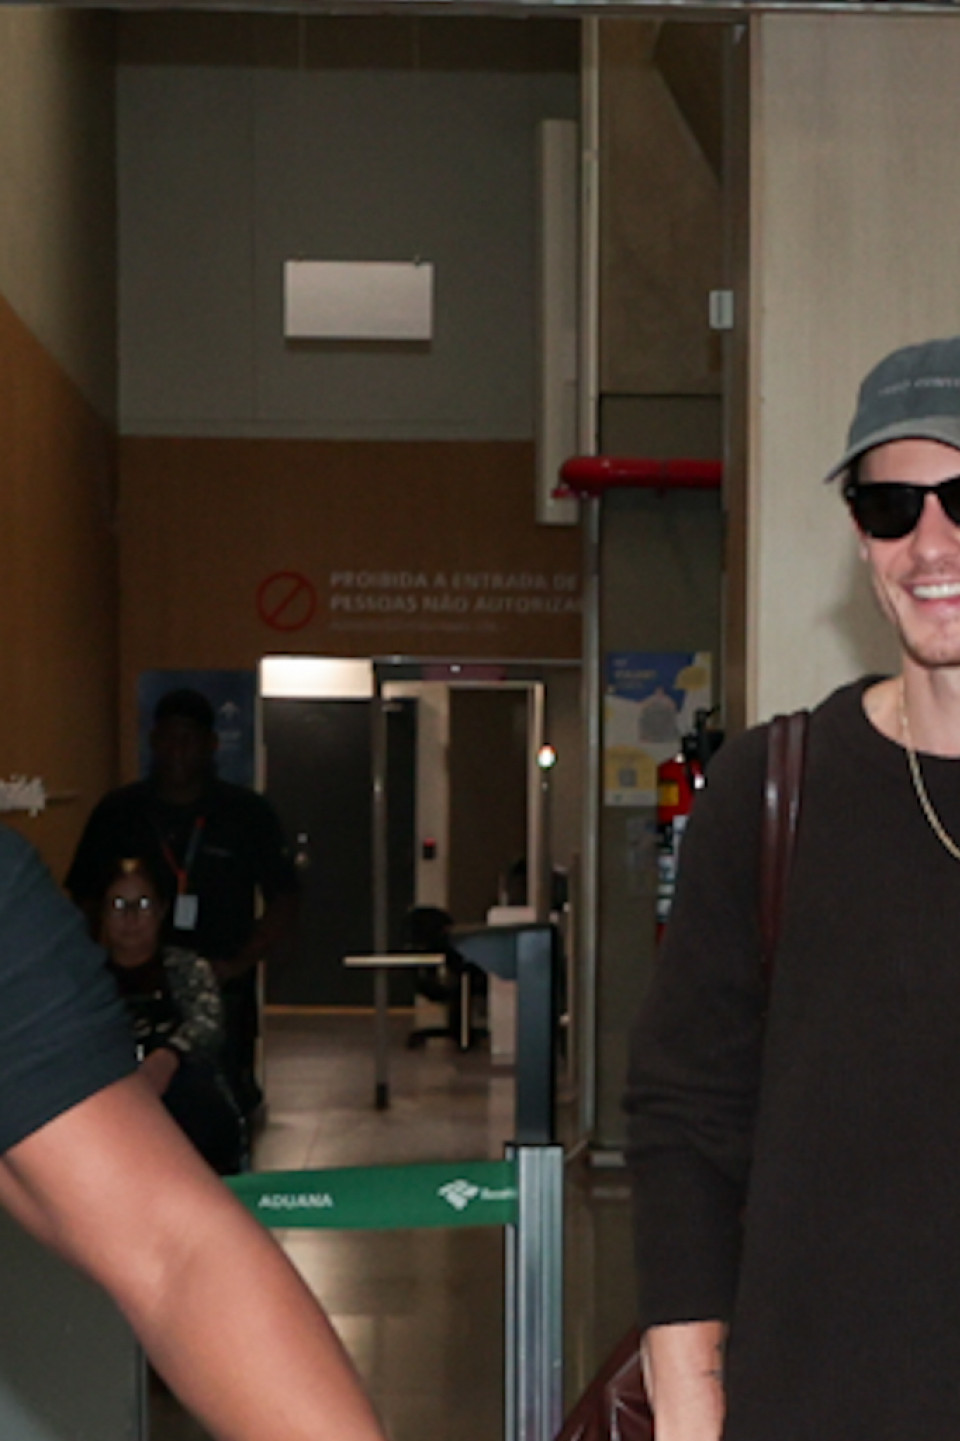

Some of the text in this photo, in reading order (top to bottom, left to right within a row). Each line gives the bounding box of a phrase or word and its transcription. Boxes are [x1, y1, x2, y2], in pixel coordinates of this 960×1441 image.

[330, 571, 578, 591] PROIBIDA A ENTRADA DE
[330, 592, 583, 614] PESSOAS NÃO AUTORIZA
[257, 1192, 334, 1210] ADUANA
